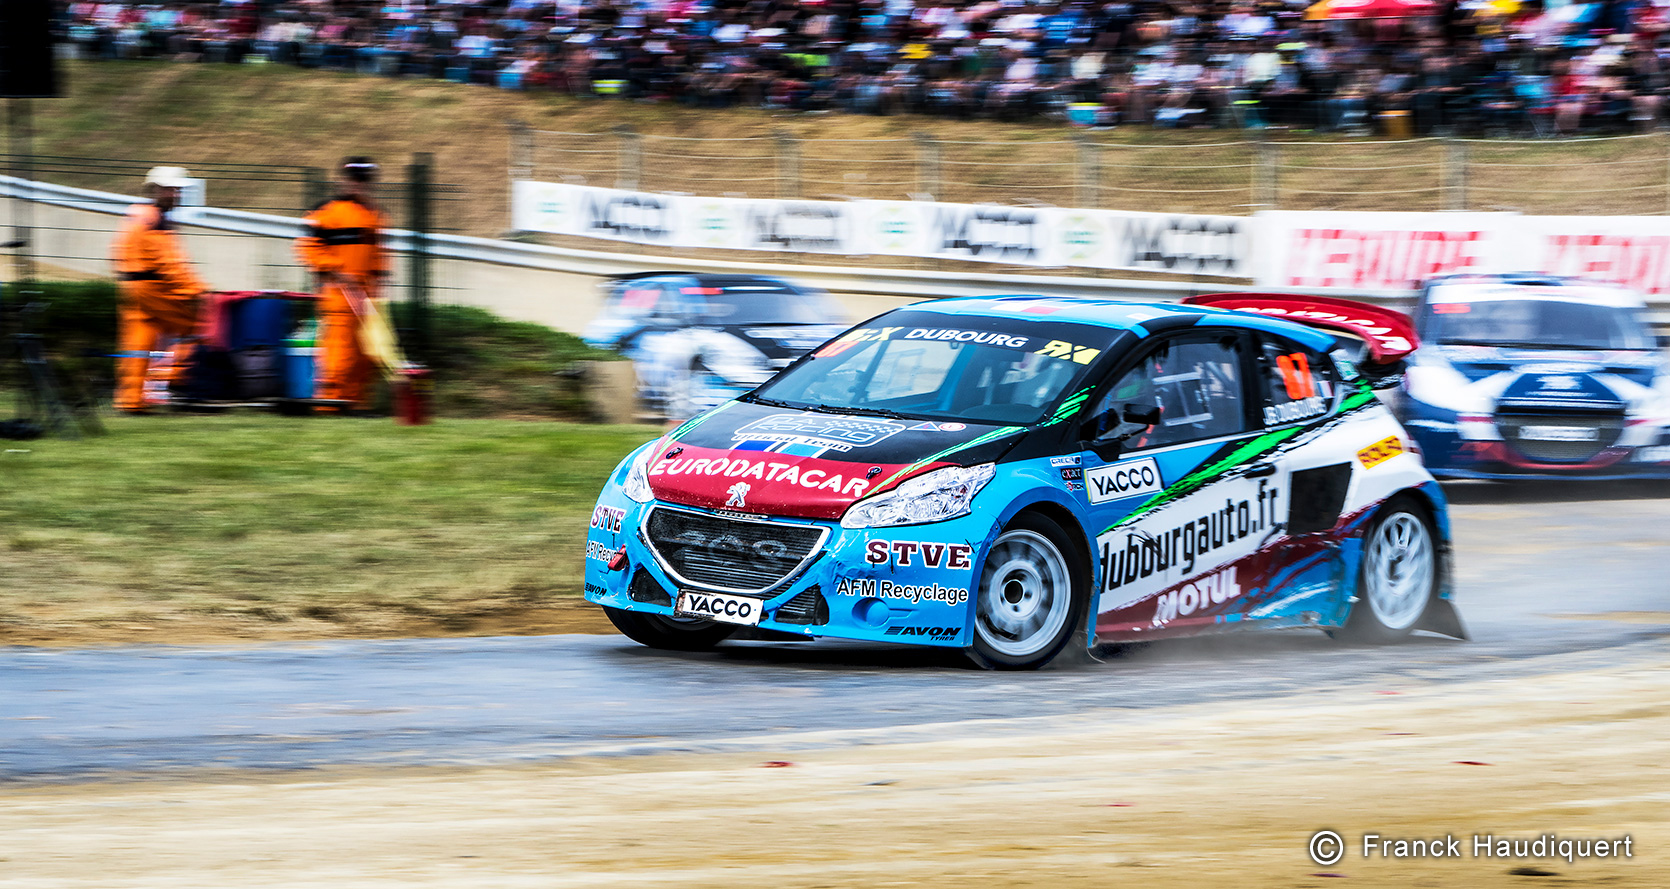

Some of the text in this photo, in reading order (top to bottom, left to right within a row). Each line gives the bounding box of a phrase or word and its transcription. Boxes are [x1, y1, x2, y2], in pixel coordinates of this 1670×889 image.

[905, 328, 1030, 348] DUBOURG
[650, 457, 870, 498] EURODATACAR
[1092, 466, 1155, 496] YACCO
[591, 505, 626, 533] STVE
[866, 541, 971, 570] STVE
[587, 583, 608, 597] AVON
[837, 578, 968, 605] AFM Recyclage
[1154, 566, 1241, 622] MOTUL
[689, 594, 751, 618] YACCO
[900, 626, 962, 636] AVON
